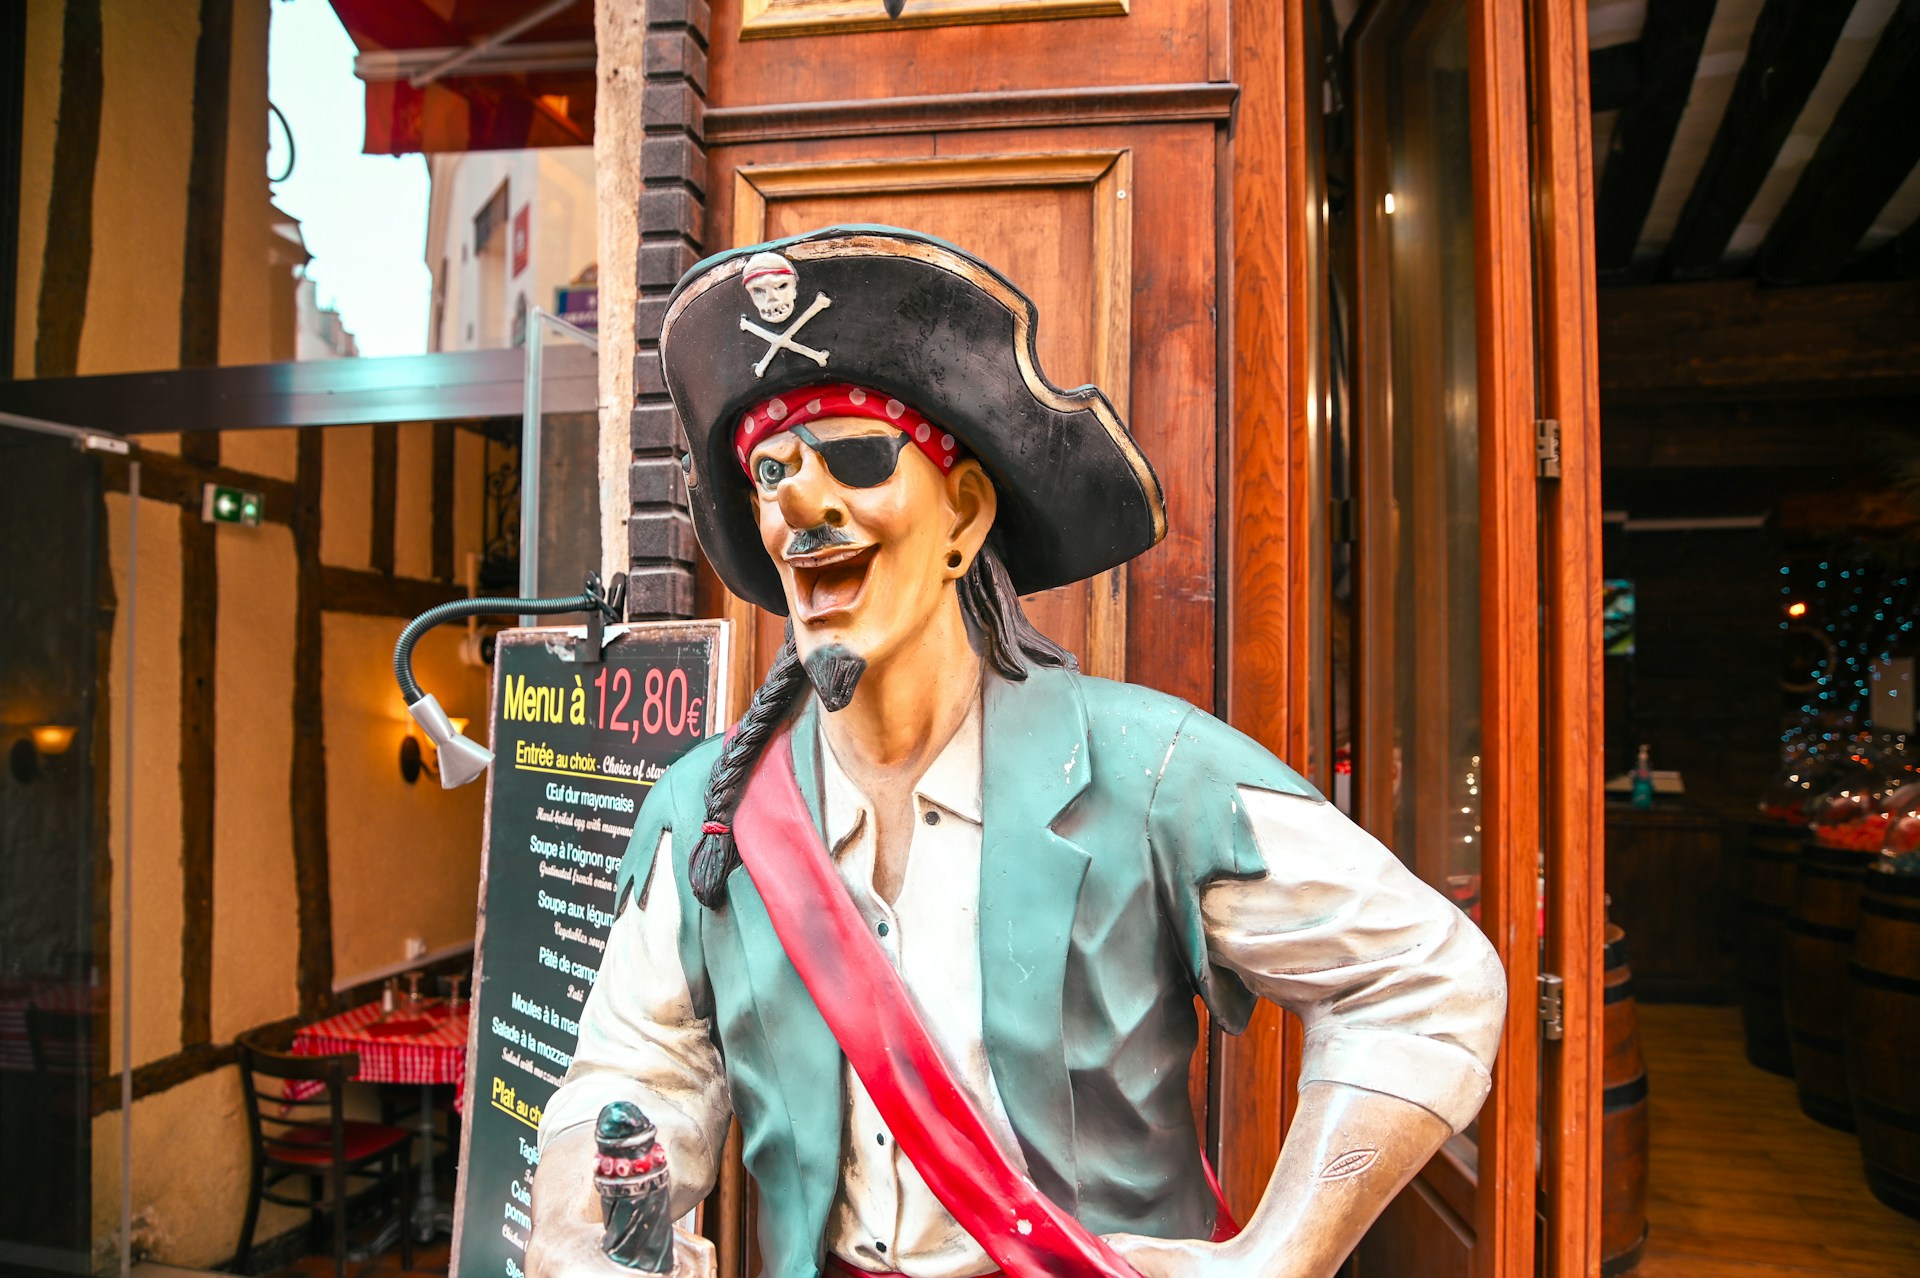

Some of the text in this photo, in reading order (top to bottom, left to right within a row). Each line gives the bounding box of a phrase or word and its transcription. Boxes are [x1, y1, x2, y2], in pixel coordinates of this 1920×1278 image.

[504, 666, 703, 744] Menu à 12,80€
[515, 740, 554, 766] Entrée
[555, 753, 568, 768] au
[569, 751, 596, 771] choix
[600, 754, 631, 777] Choice
[632, 758, 645, 781] of
[546, 782, 635, 813] Œuf dur mayonnaise
[573, 818, 585, 832] egg
[586, 817, 602, 832] with
[530, 835, 558, 858] Soupe
[559, 841, 566, 860] à
[537, 889, 567, 915] Soupe
[567, 902, 585, 920] aux
[538, 946, 559, 969] Pâté
[558, 954, 571, 974] de
[588, 938, 606, 954] soup
[511, 992, 543, 1021] Moules
[542, 1005, 550, 1025] à
[550, 1008, 560, 1029] la
[491, 1016, 520, 1045] Salade
[519, 1029, 528, 1048] à
[527, 1032, 537, 1053] la
[492, 1076, 516, 1109] Plat
[516, 1098, 529, 1117] au
